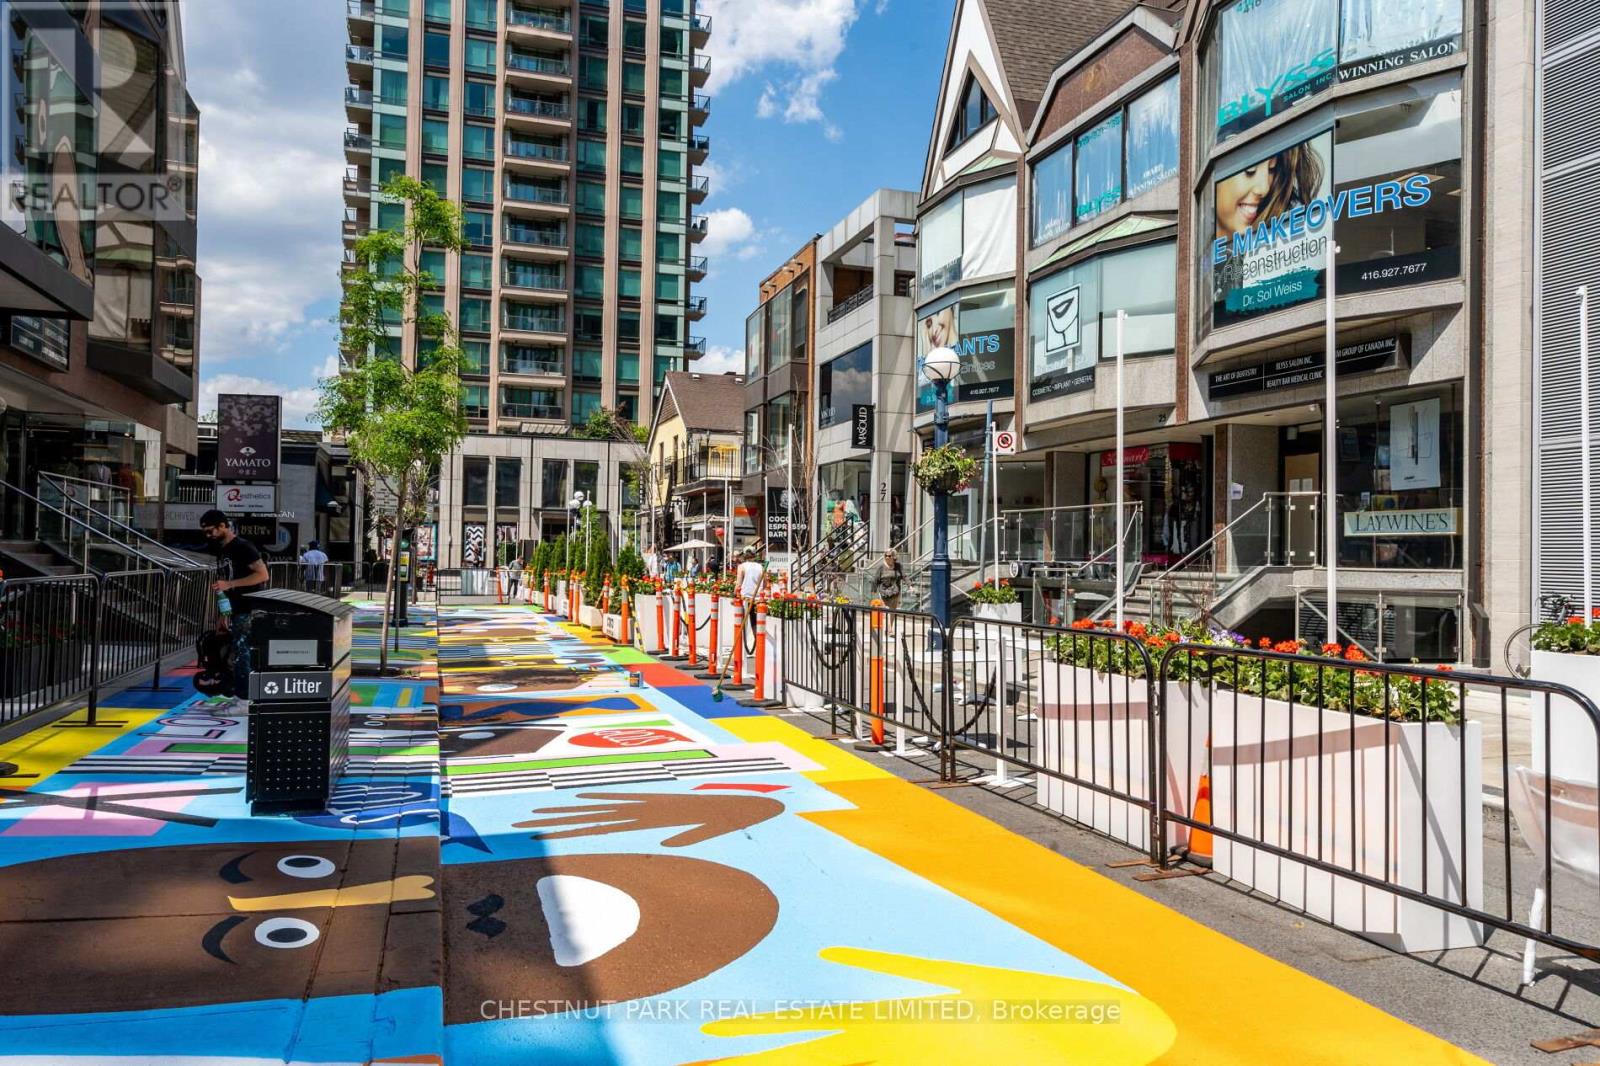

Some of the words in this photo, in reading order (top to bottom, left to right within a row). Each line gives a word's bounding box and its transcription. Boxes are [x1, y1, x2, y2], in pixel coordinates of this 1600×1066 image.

[1338, 55, 1404, 81] WINNING
[1410, 40, 1459, 62] SALON
[1217, 47, 1336, 128] BLYSS
[1282, 83, 1312, 103] SALON
[1232, 174, 1433, 257] MAKEOVERS
[1361, 262, 1428, 282] 416.927.7677
[1243, 295, 1255, 307] Dr.
[1257, 288, 1273, 303] Sol
[1274, 281, 1303, 298] Weiss
[225, 458, 271, 467] YAMATO
[1355, 512, 1448, 532] LAYWINE'S
[284, 677, 322, 694] Litter
